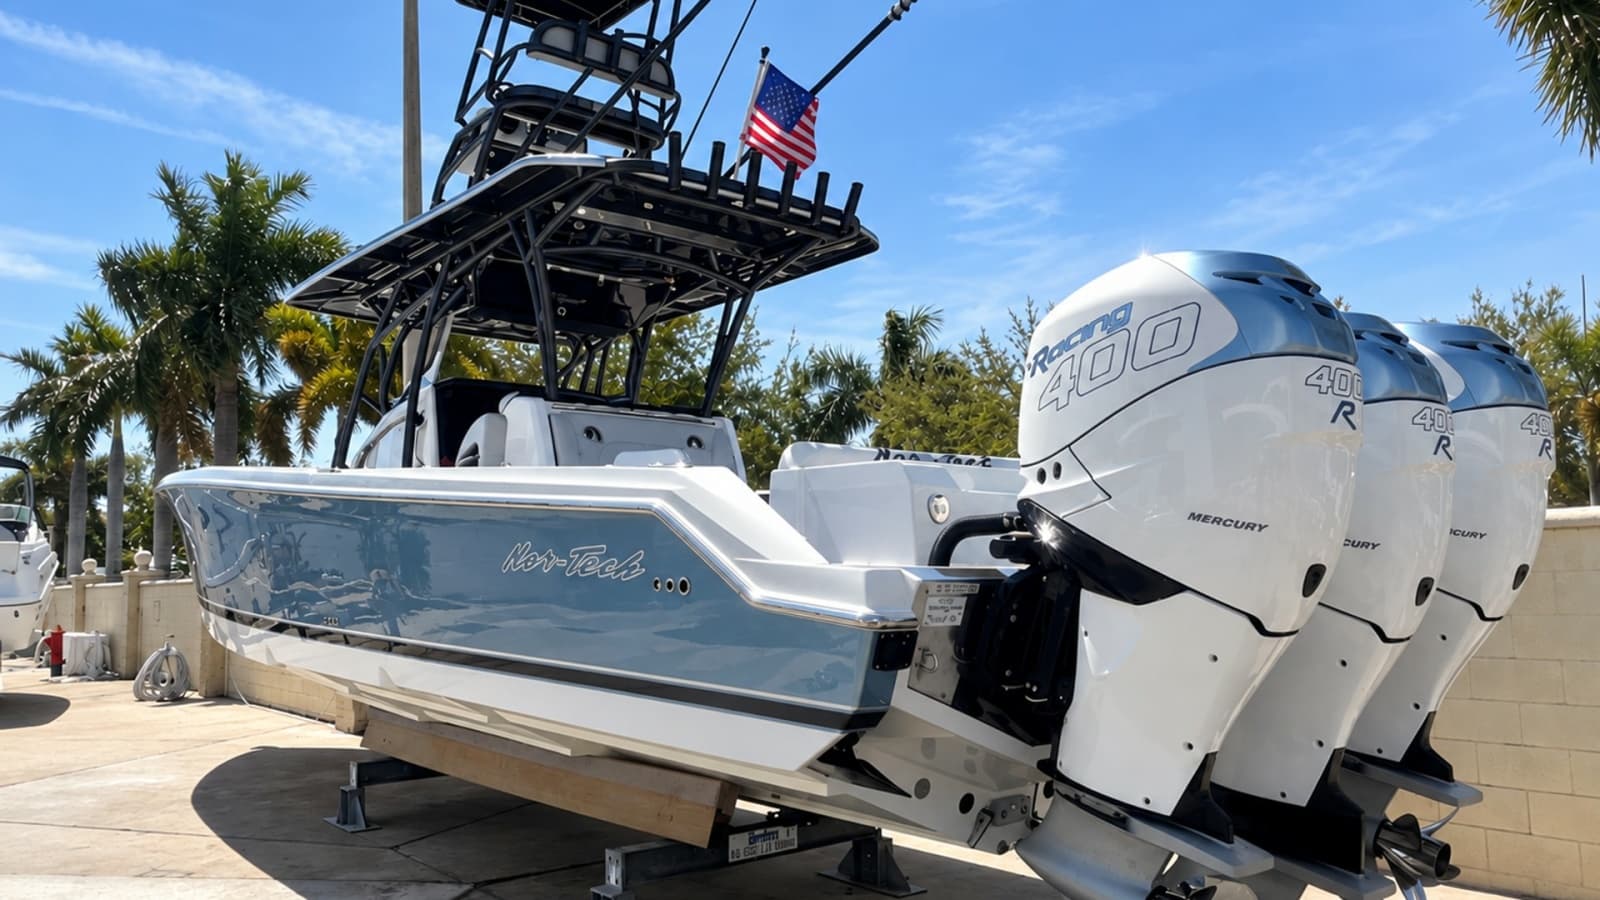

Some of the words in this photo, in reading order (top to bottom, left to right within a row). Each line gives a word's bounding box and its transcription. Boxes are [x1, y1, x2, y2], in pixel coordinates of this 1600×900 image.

[1030, 302, 1133, 378] Racing
[1038, 302, 1201, 412] 400
[1330, 400, 1357, 430] R
[1520, 412, 1555, 440] 40
[1433, 435, 1453, 461] R
[1538, 438, 1553, 461] R
[1187, 511, 1269, 533] MERCURY
[1449, 528, 1487, 540] CURY
[502, 541, 646, 582] Nor-Tech
